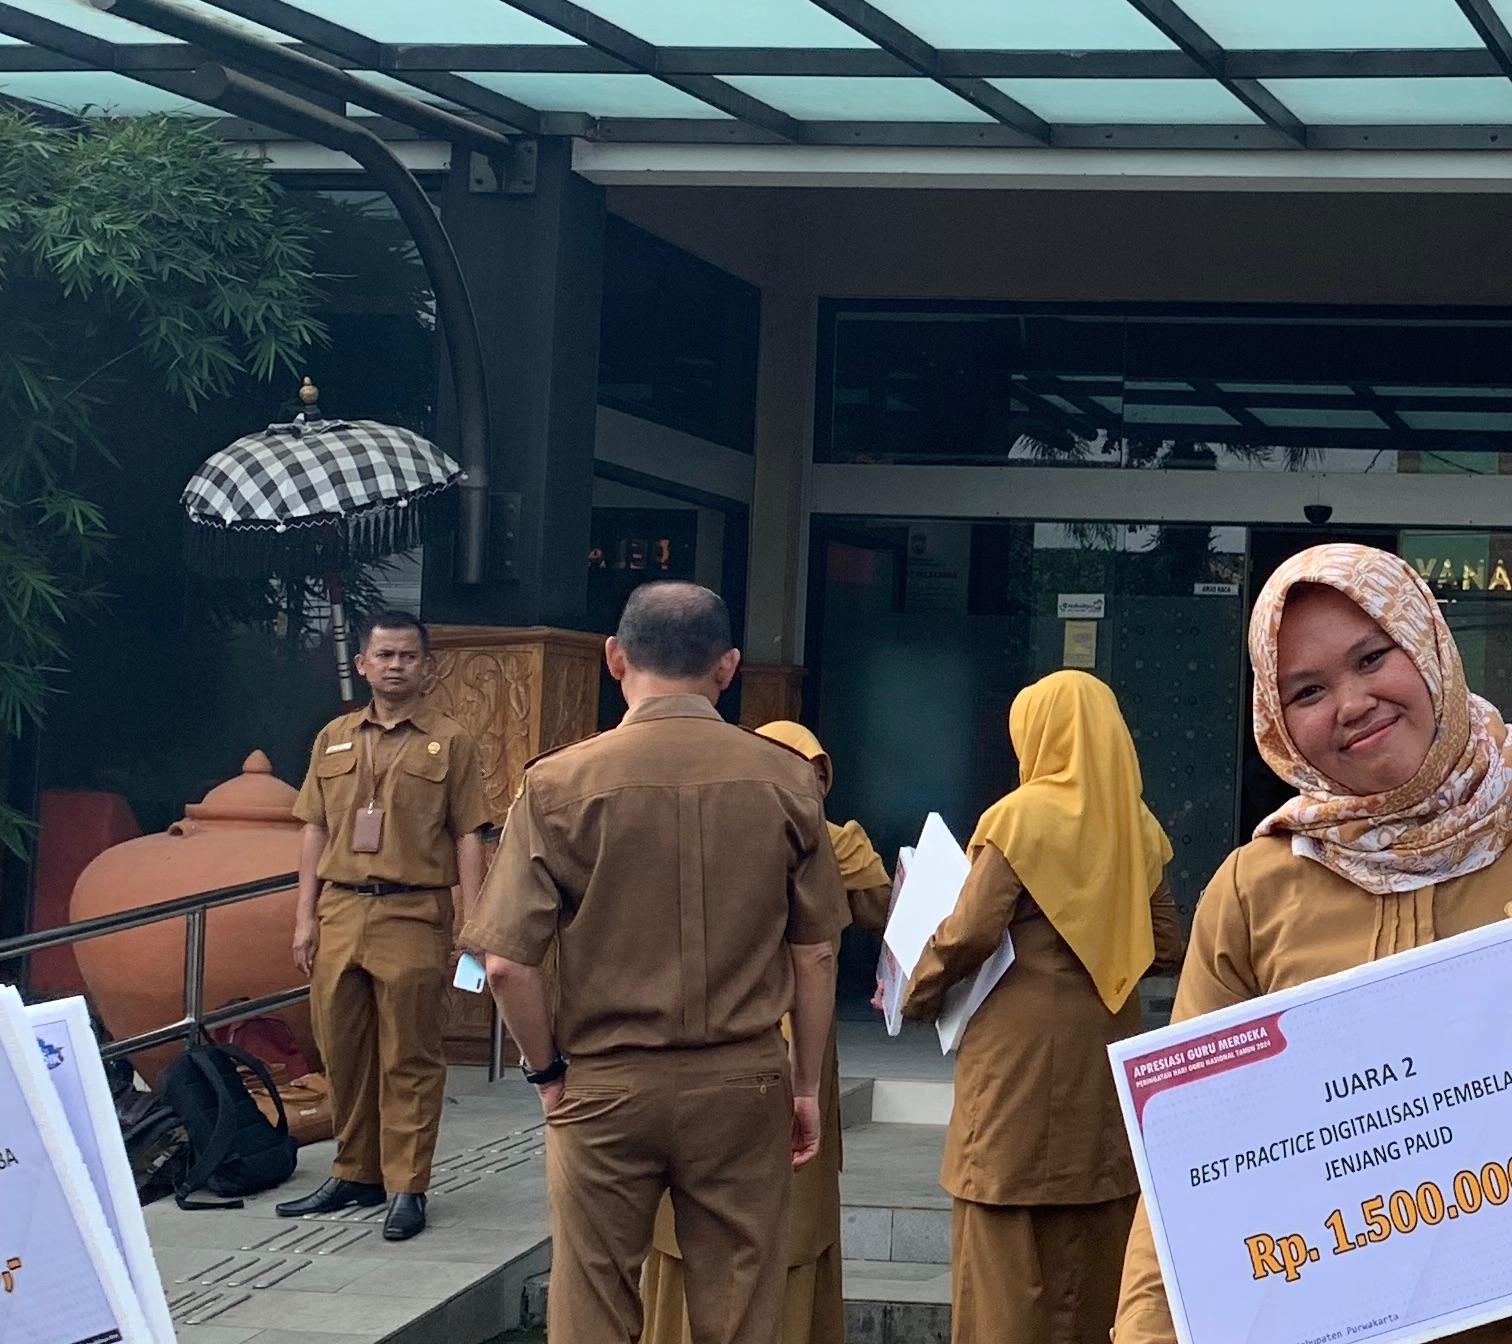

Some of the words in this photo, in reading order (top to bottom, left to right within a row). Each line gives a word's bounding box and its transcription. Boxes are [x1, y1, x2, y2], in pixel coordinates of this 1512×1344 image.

[1134, 1053, 1185, 1078] APRESIASI
[1187, 1042, 1216, 1060] GURU
[1218, 1027, 1267, 1050] MERDEKA
[1173, 1067, 1187, 1076] HARI
[1206, 1052, 1235, 1065] NASIONAL
[1325, 1064, 1398, 1102] JUARA
[1402, 1057, 1416, 1077] 2
[1191, 1158, 1229, 1186] BEST
[1236, 1131, 1315, 1172] PRACTICE
[1320, 1097, 1429, 1145] DIGITALISASI
[1326, 1142, 1400, 1180] JENJANG
[1405, 1127, 1452, 1155] PAUD
[1244, 1233, 1320, 1282] Rp.
[1347, 1315, 1399, 1335] Purwakarta
